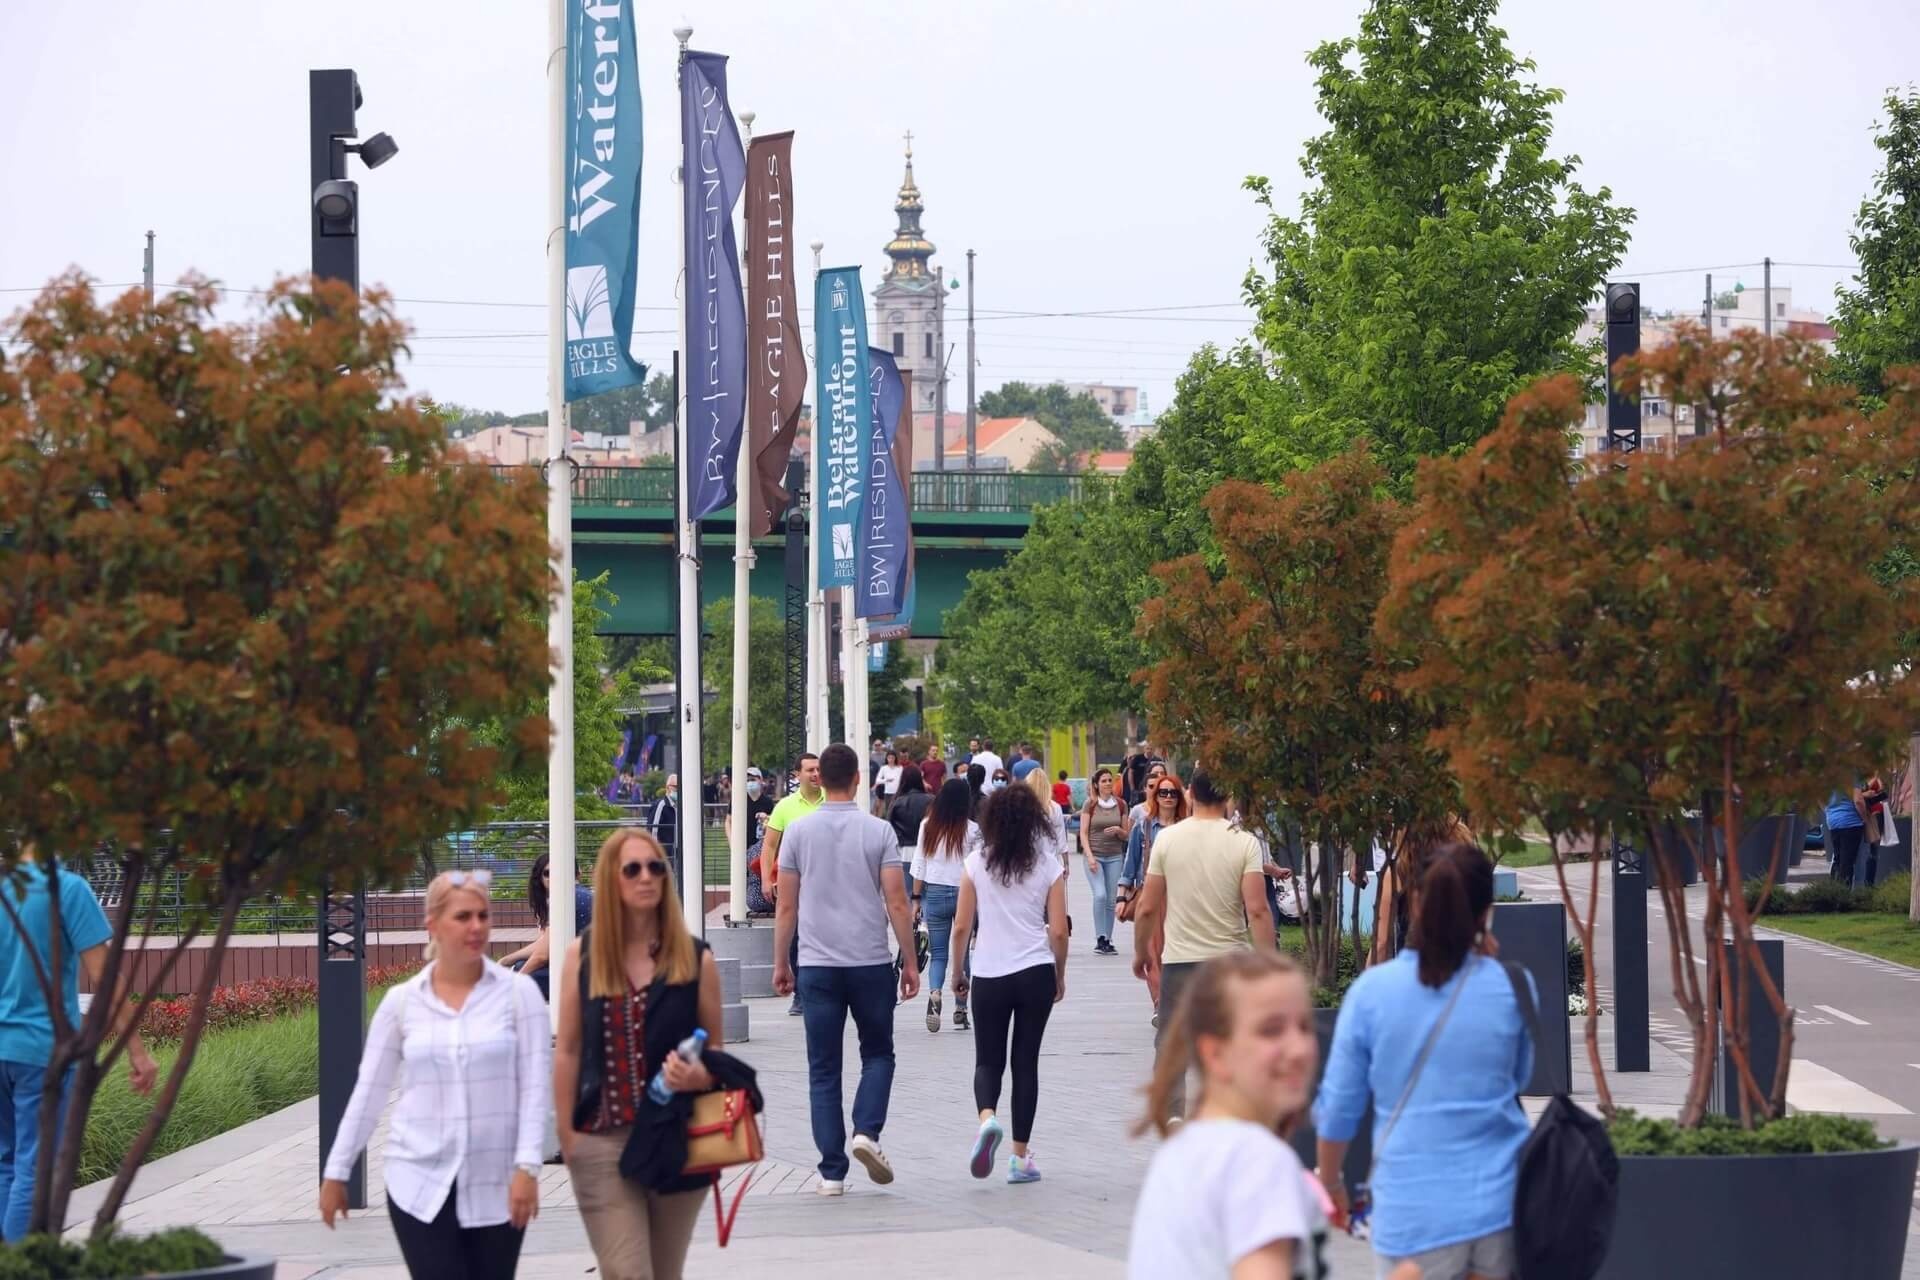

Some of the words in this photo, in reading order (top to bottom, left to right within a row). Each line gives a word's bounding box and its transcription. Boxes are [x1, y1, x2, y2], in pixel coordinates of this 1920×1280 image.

[767, 154, 783, 281] HILLS
[825, 362, 844, 513] Belgrade
[869, 553, 891, 598] BW
